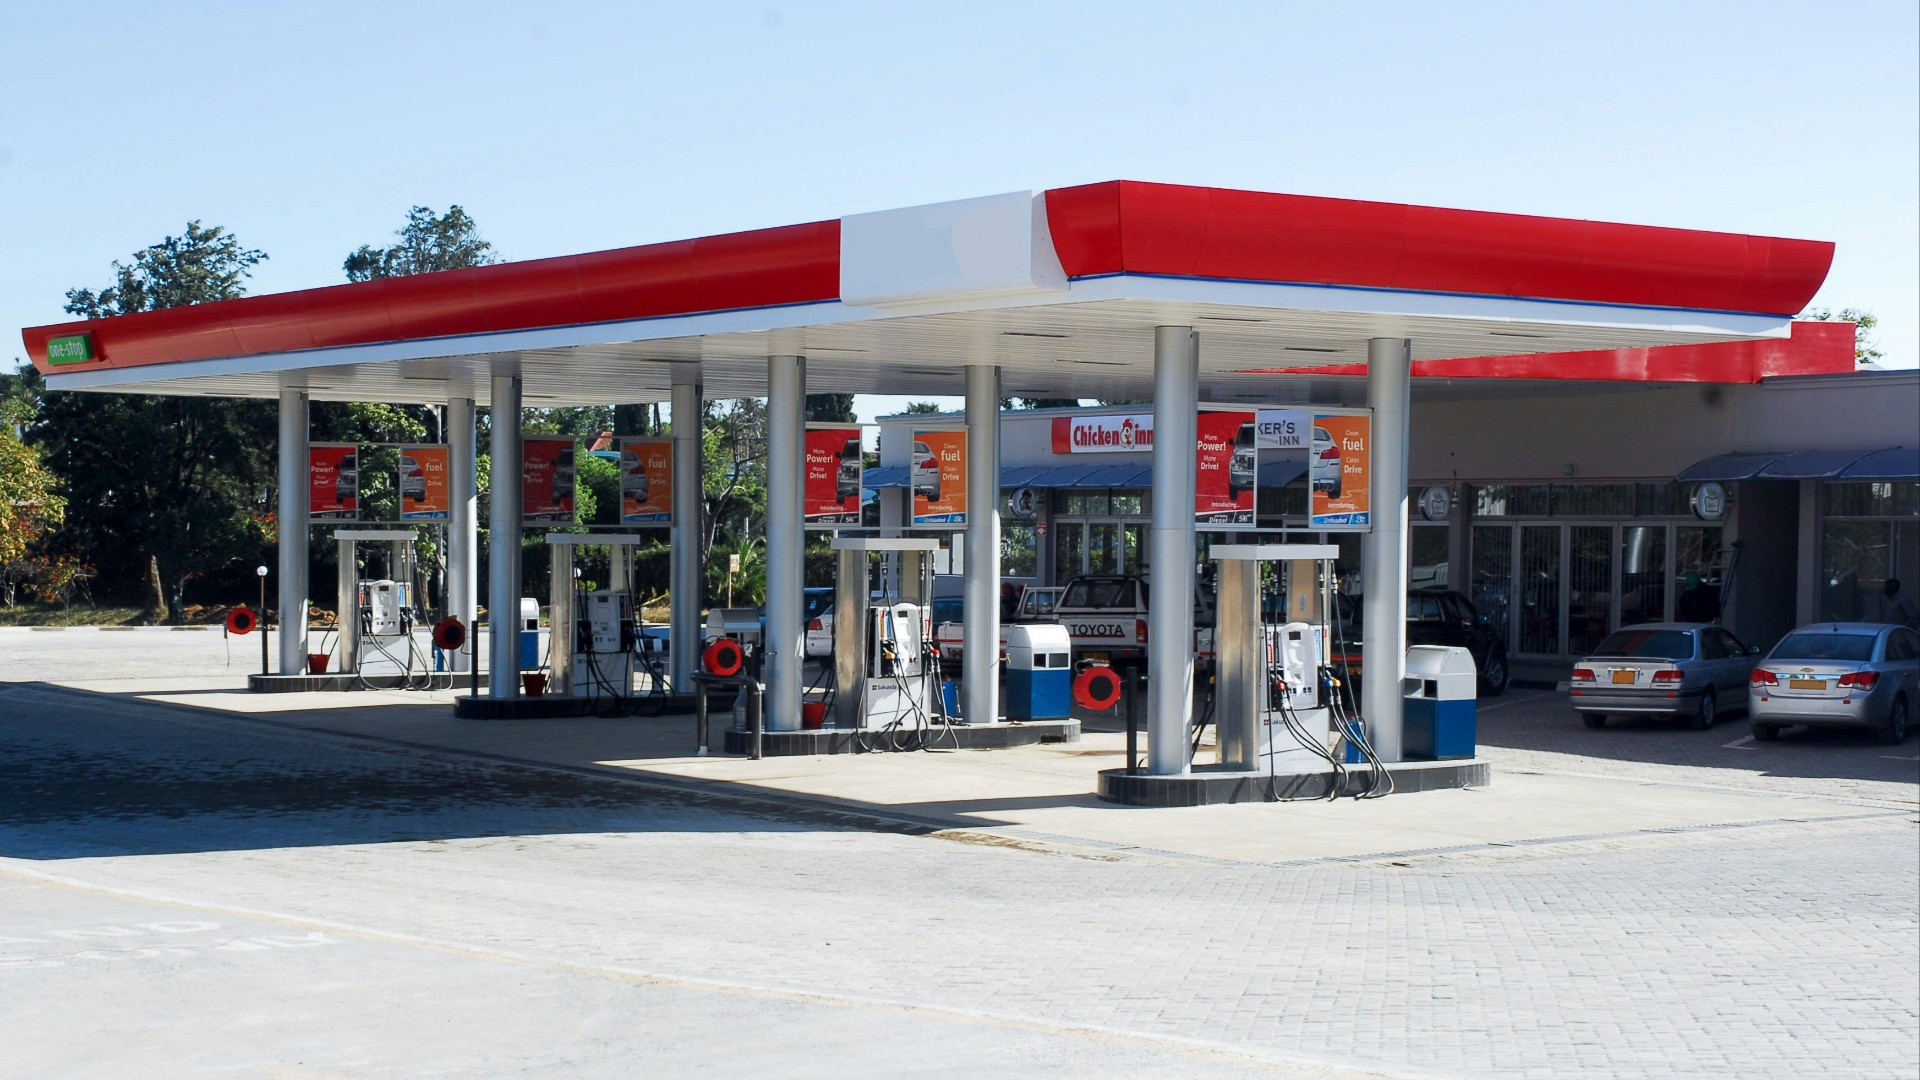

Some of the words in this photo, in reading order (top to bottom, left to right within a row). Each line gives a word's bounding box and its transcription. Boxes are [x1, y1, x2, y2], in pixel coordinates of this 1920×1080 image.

[49, 340, 83, 360] one-stop
[1073, 425, 1120, 446] Chicken
[1134, 423, 1154, 445] inn
[1279, 435, 1300, 446] INN
[1342, 438, 1364, 451] fuel
[1197, 441, 1226, 451] Power!
[806, 454, 833, 463] Power!
[941, 450, 961, 461] fuel
[426, 462, 443, 471] fuel
[525, 461, 549, 469] Power!
[648, 458, 667, 468] fuel
[1344, 465, 1362, 473] Drive
[1070, 624, 1124, 635] TOYOTA
